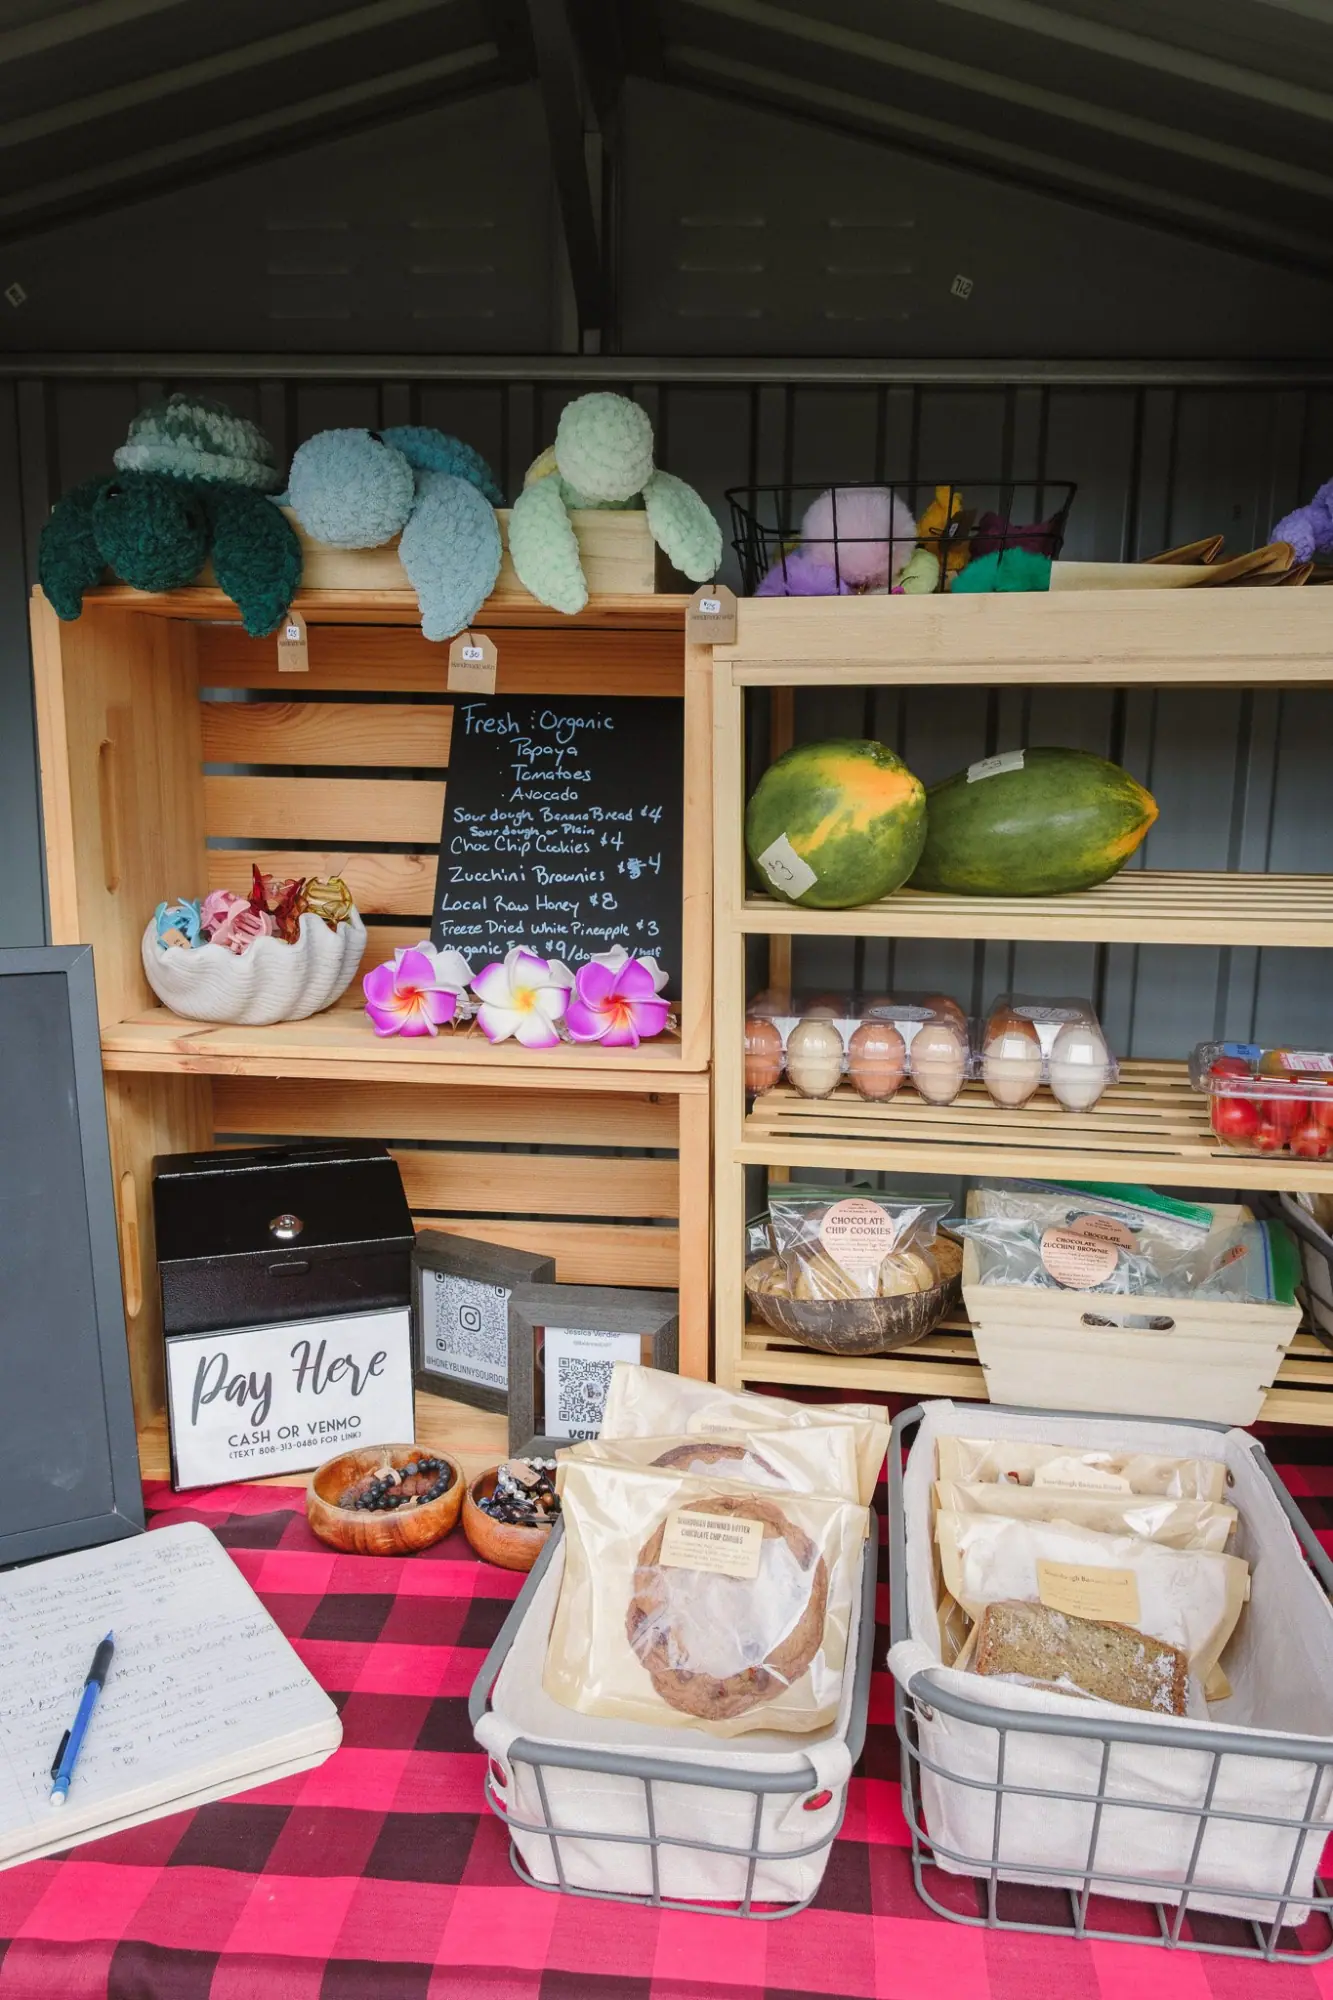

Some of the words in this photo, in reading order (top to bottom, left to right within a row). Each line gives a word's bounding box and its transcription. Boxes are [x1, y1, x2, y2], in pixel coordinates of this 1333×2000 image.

[461, 703, 520, 734] Fresh
[509, 737, 578, 766] Papaya
[511, 764, 592, 781] Tomatoes
[509, 786, 579, 803] Avocado
[640, 805, 663, 824] $4
[561, 823, 595, 836] Plain
[450, 836, 490, 855] Choc
[494, 836, 531, 857] Chip
[535, 834, 591, 854] Cookies
[600, 831, 625, 851] $4
[448, 865, 526, 883] Zucchini
[531, 865, 605, 885] Brownies
[441, 893, 487, 911] Local
[494, 895, 529, 912] Raw
[536, 895, 580, 918] Honey
[589, 892, 618, 910] $8
[440, 920, 483, 936] Freeze
[485, 919, 524, 935] Dried
[571, 923, 630, 941] Pineapple
[636, 919, 660, 936] $3
[825, 1226, 847, 1234] CHIP
[850, 1227, 891, 1235] COOKIES
[831, 1216, 885, 1225] CHOCOLATE
[1043, 1242, 1076, 1251] ZUCCHINI
[1077, 1244, 1110, 1255] BROWNIE
[1055, 1236, 1097, 1247] CHOCOLATE
[191, 1352, 272, 1427] Pay
[290, 1339, 388, 1397] Here
[227, 1429, 271, 1447] CASH
[277, 1424, 300, 1440] OR
[307, 1415, 362, 1435] VENMO
[229, 1448, 255, 1459] (TEXT
[259, 1438, 318, 1455] 808-313-0480
[320, 1435, 338, 1444] FOR
[341, 1431, 362, 1441] LINK)
